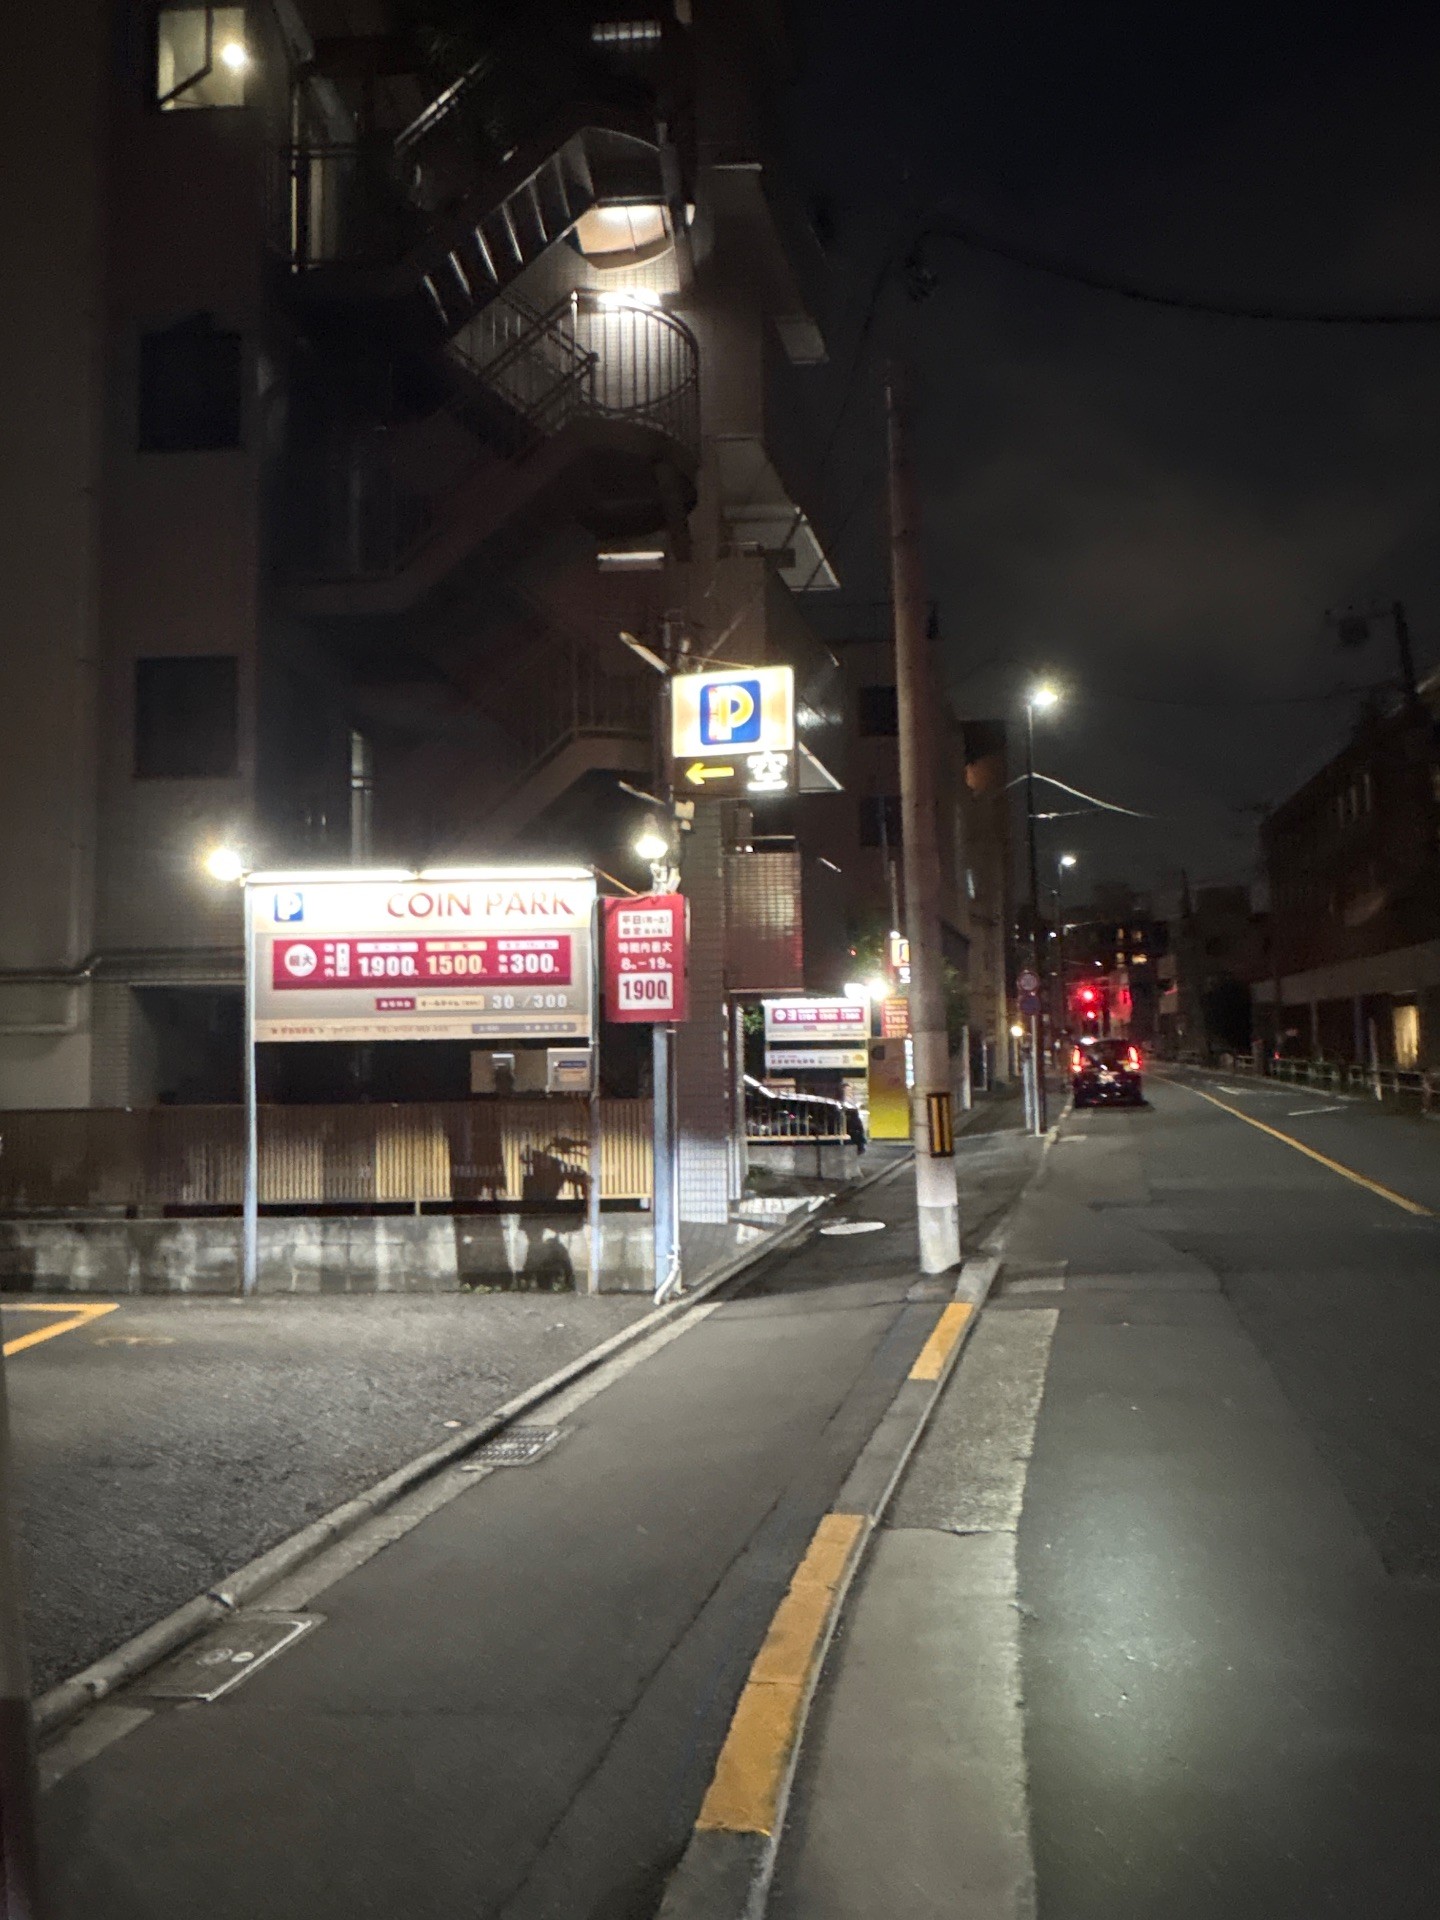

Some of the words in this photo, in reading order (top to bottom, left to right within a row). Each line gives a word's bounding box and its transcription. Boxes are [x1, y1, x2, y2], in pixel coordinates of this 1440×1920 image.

[708, 684, 754, 741] P
[387, 891, 472, 918] COIN
[485, 890, 576, 916] PARK
